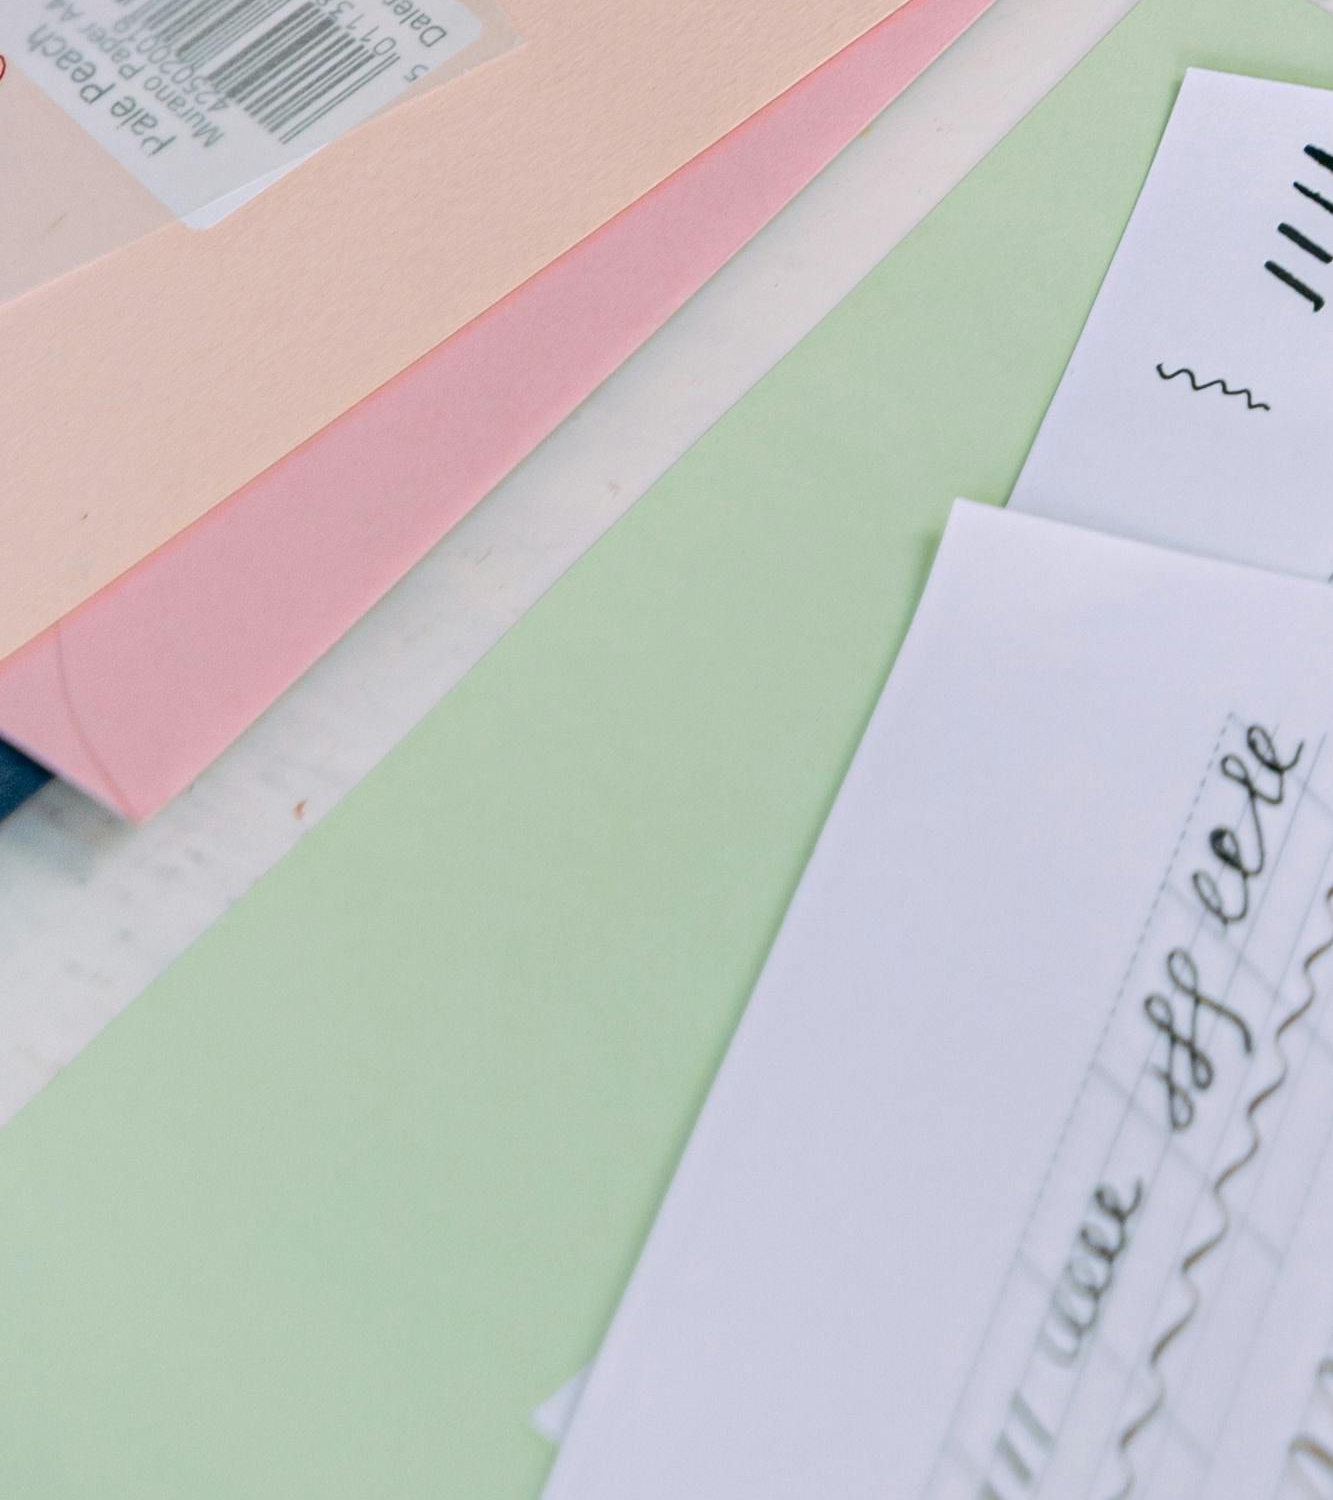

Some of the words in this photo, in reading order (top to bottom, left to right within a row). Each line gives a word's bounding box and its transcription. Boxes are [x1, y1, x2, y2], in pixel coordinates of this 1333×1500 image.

[28, 26, 116, 104] Peach
[82, 24, 146, 80] Paper
[404, 63, 431, 84] 5
[144, 76, 224, 148] Murano
